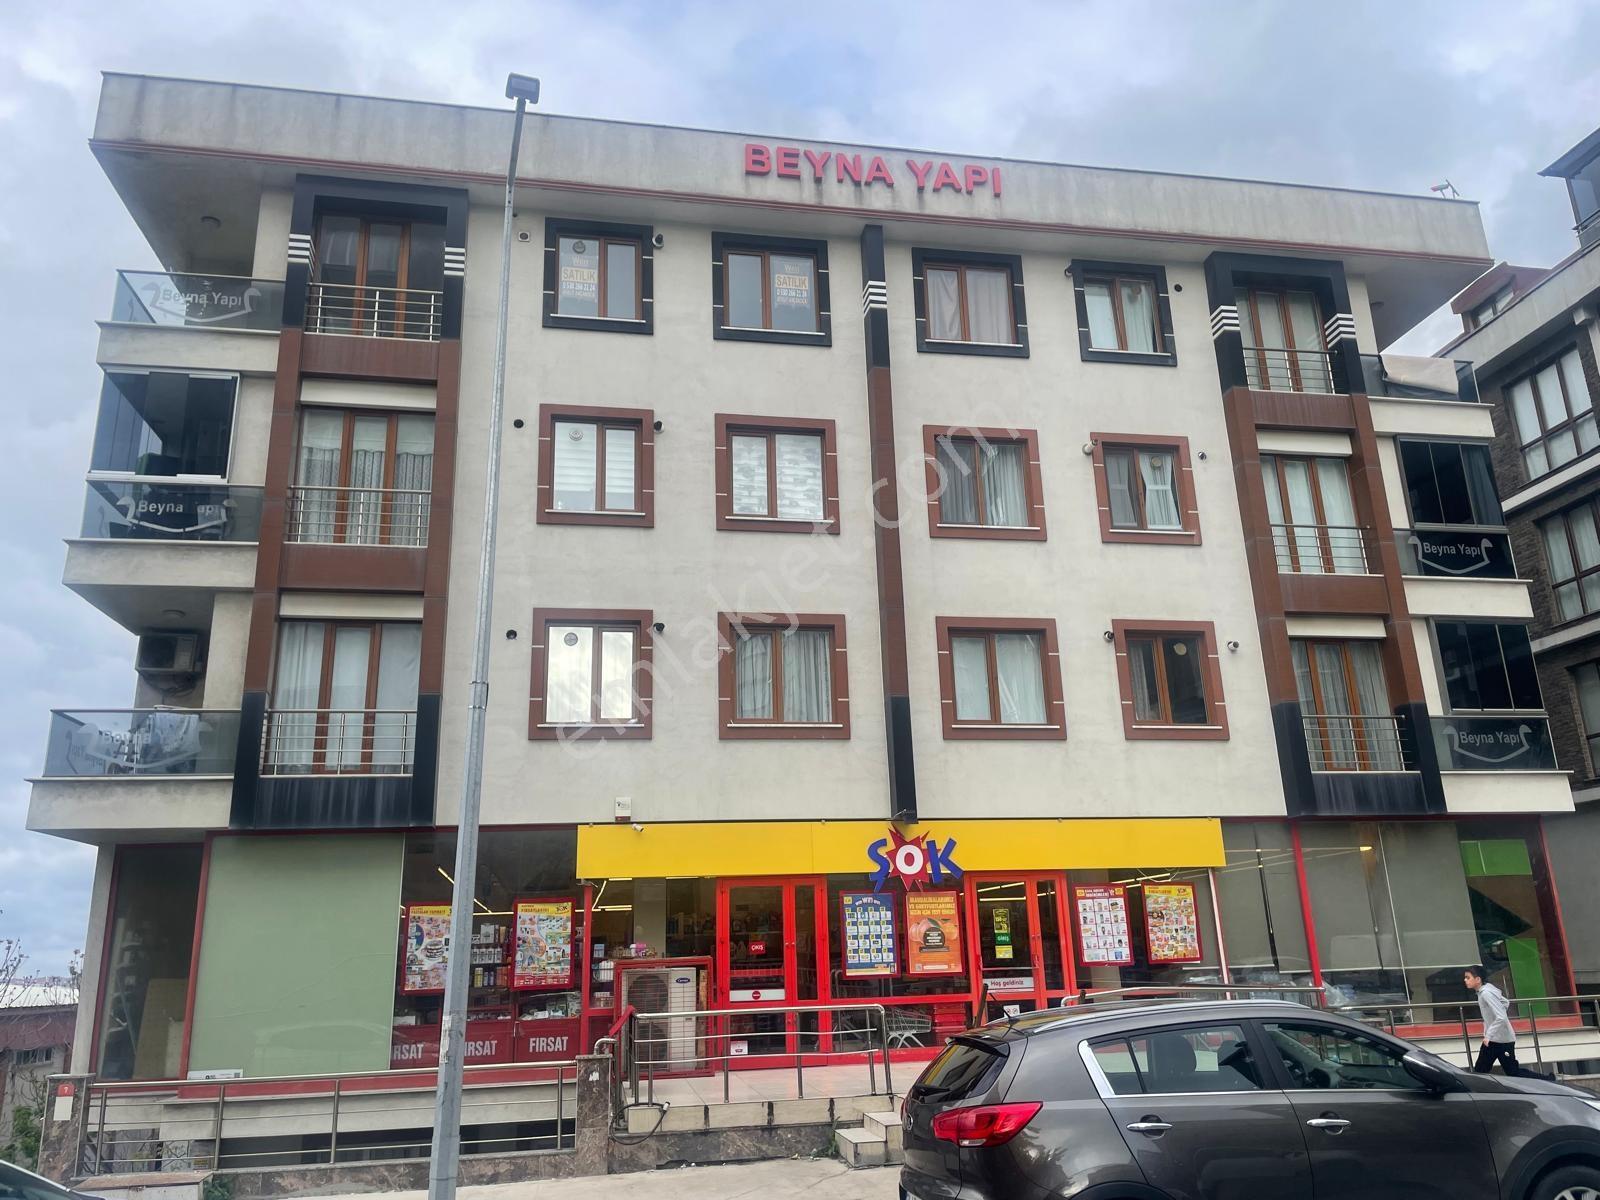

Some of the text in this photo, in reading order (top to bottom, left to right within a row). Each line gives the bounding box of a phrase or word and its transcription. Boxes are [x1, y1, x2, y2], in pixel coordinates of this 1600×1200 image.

[744, 143, 1001, 198] BEYNA YAPI
[563, 268, 596, 281] SATILIK
[776, 275, 807, 288] SATILIK
[162, 288, 207, 307] Beyna
[138, 500, 184, 515] Beyna
[1423, 542, 1481, 558] Beyna Yapı
[1460, 731, 1520, 746] Beyna Yapı
[867, 838, 964, 896] ŞOK
[393, 1043, 424, 1060] RSAT
[464, 1040, 498, 1056] IRSAT
[529, 1036, 569, 1052] FIRSAT
